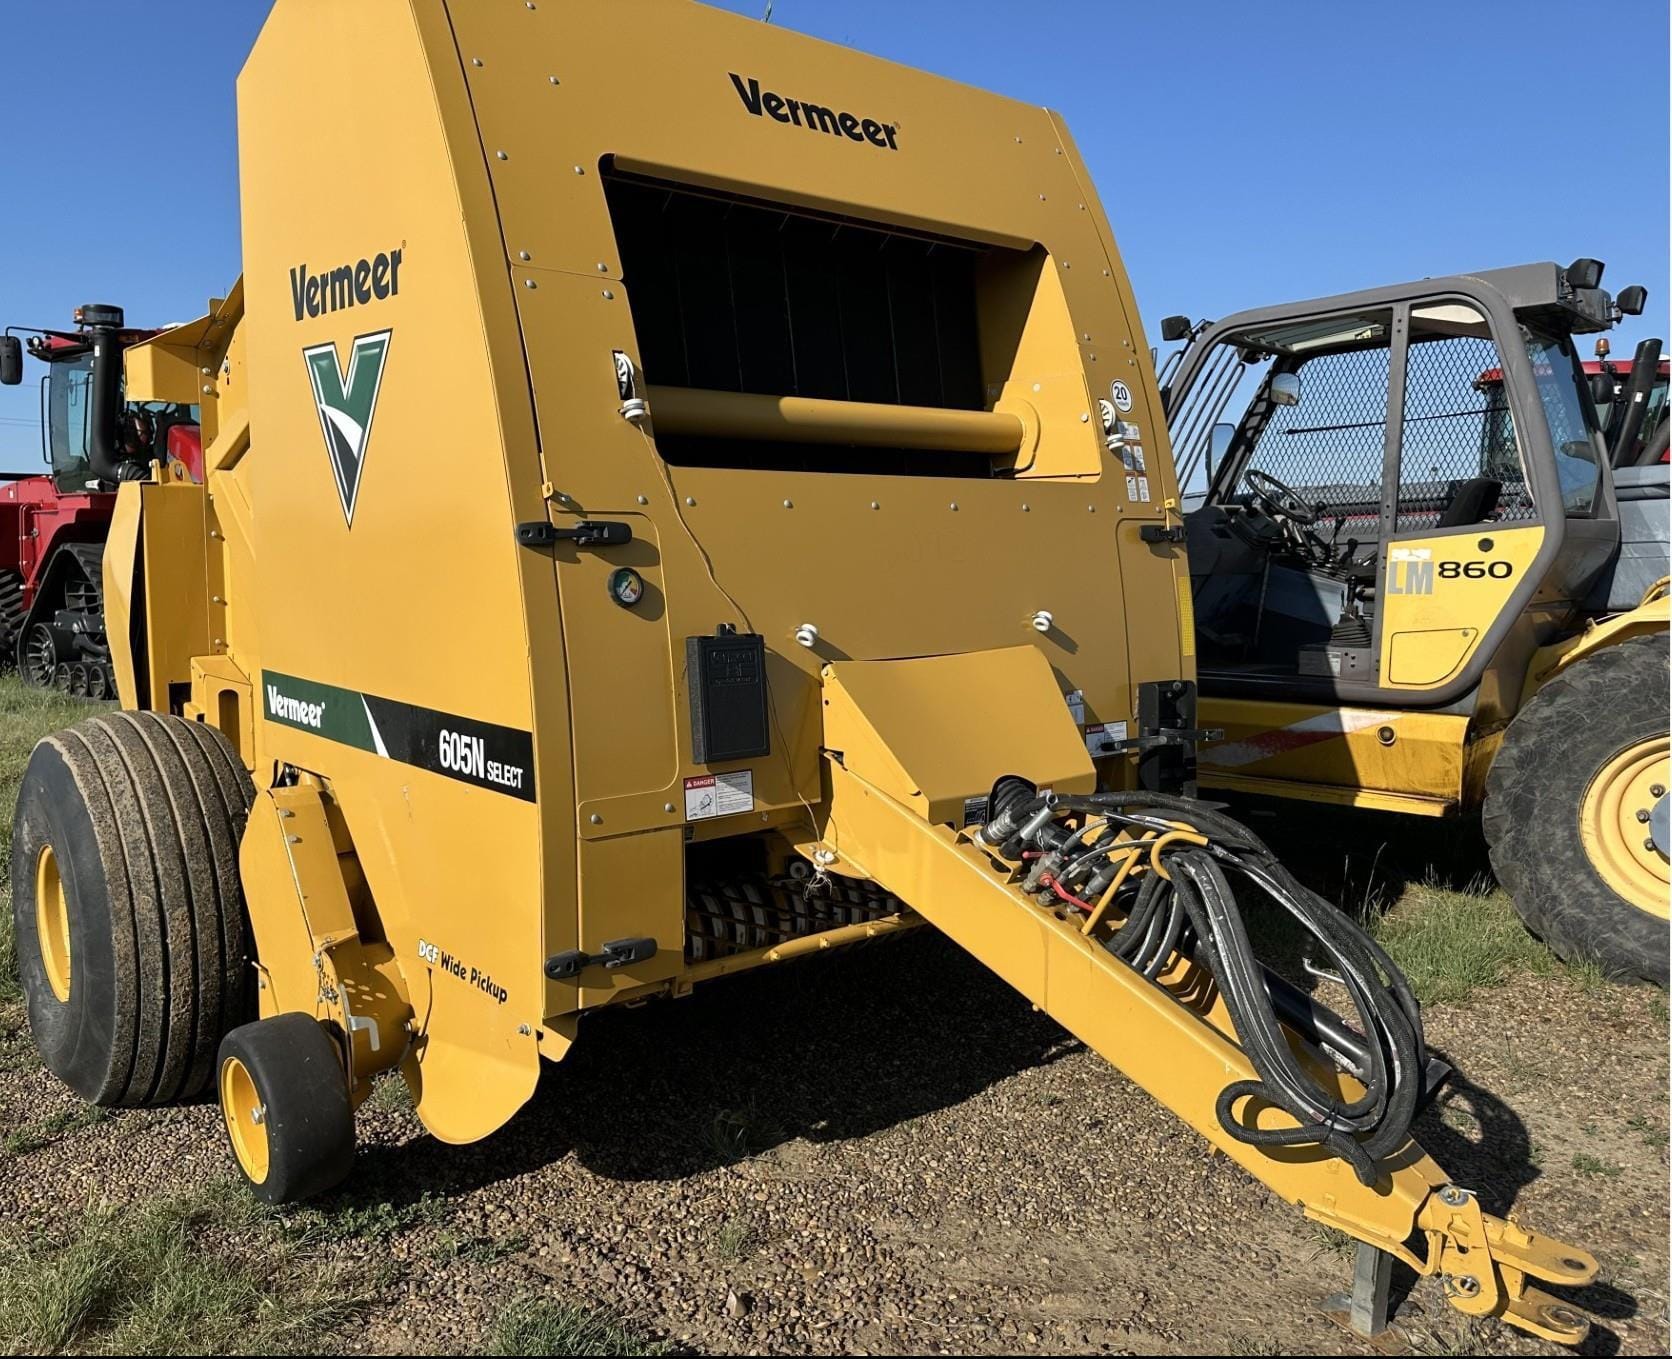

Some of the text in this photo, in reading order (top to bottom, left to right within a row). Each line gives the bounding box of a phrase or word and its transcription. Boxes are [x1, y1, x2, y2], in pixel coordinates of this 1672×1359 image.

[728, 72, 898, 150] Vermeer
[289, 247, 402, 321] Vermeer
[1113, 385, 1128, 401] 20
[1387, 561, 1513, 594] LM 860
[267, 684, 524, 789] Vermeer 605N SELECT
[693, 778, 714, 787] DANGER
[418, 938, 508, 1005] DCF Wide Pickup
